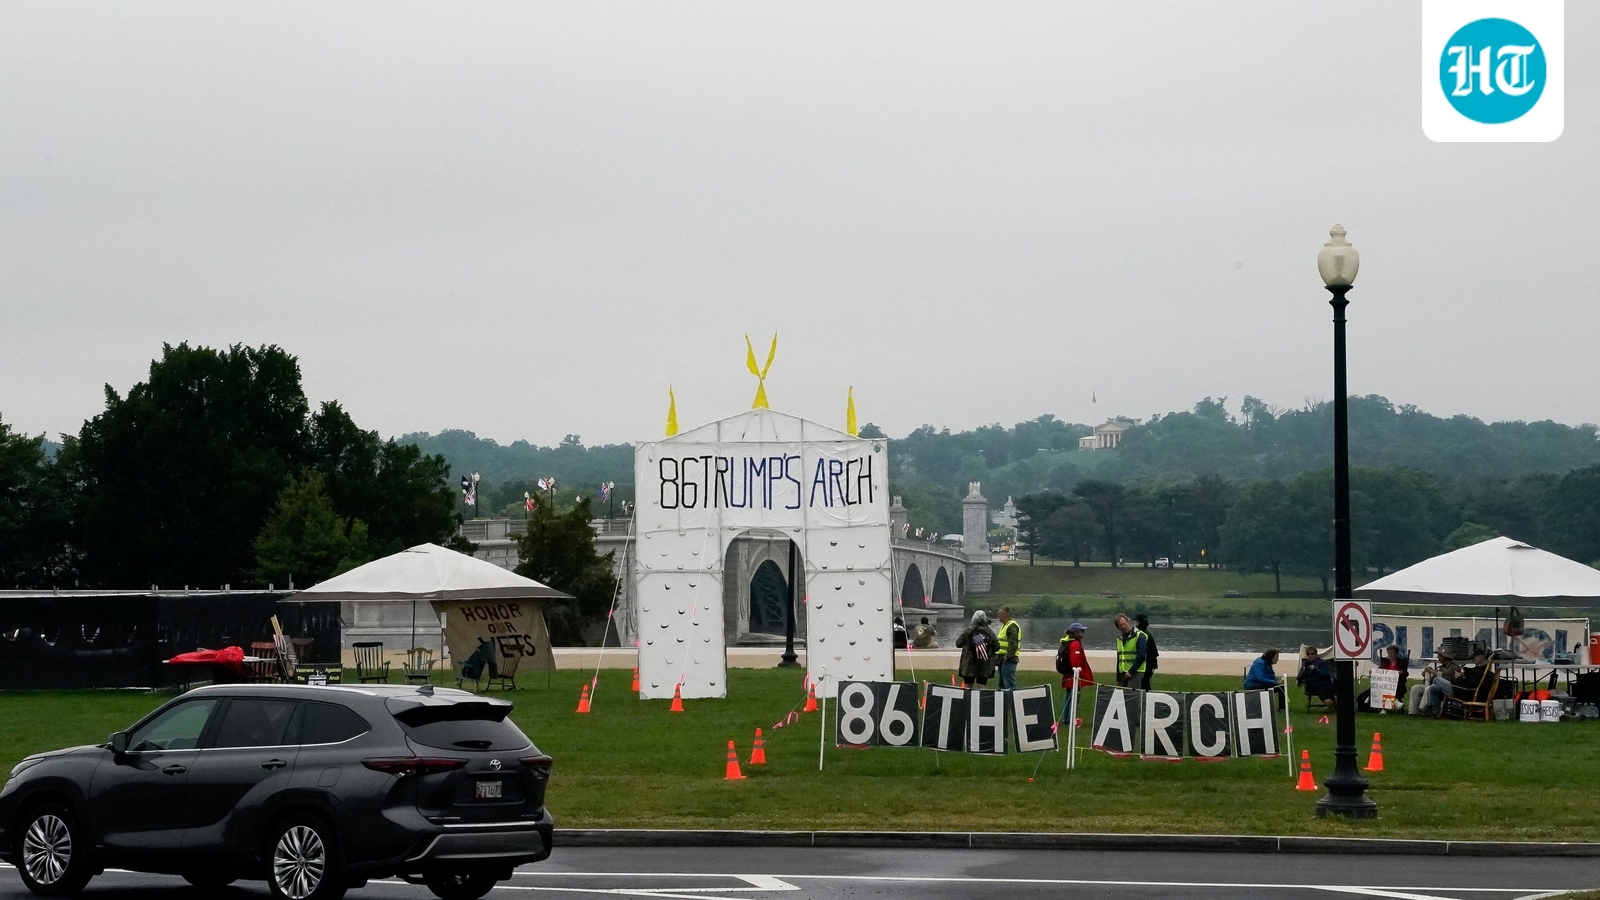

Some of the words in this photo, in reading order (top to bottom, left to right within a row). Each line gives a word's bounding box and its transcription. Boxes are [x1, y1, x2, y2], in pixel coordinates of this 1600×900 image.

[809, 455, 874, 508] ARCH
[460, 603, 524, 622] HONOR
[488, 621, 517, 634] OUR
[1520, 702, 1536, 716] ESIST
[1541, 705, 1560, 718] RESIST
[840, 682, 914, 746] 86
[931, 686, 1055, 753] THE
[1093, 688, 1277, 757] ARCH
